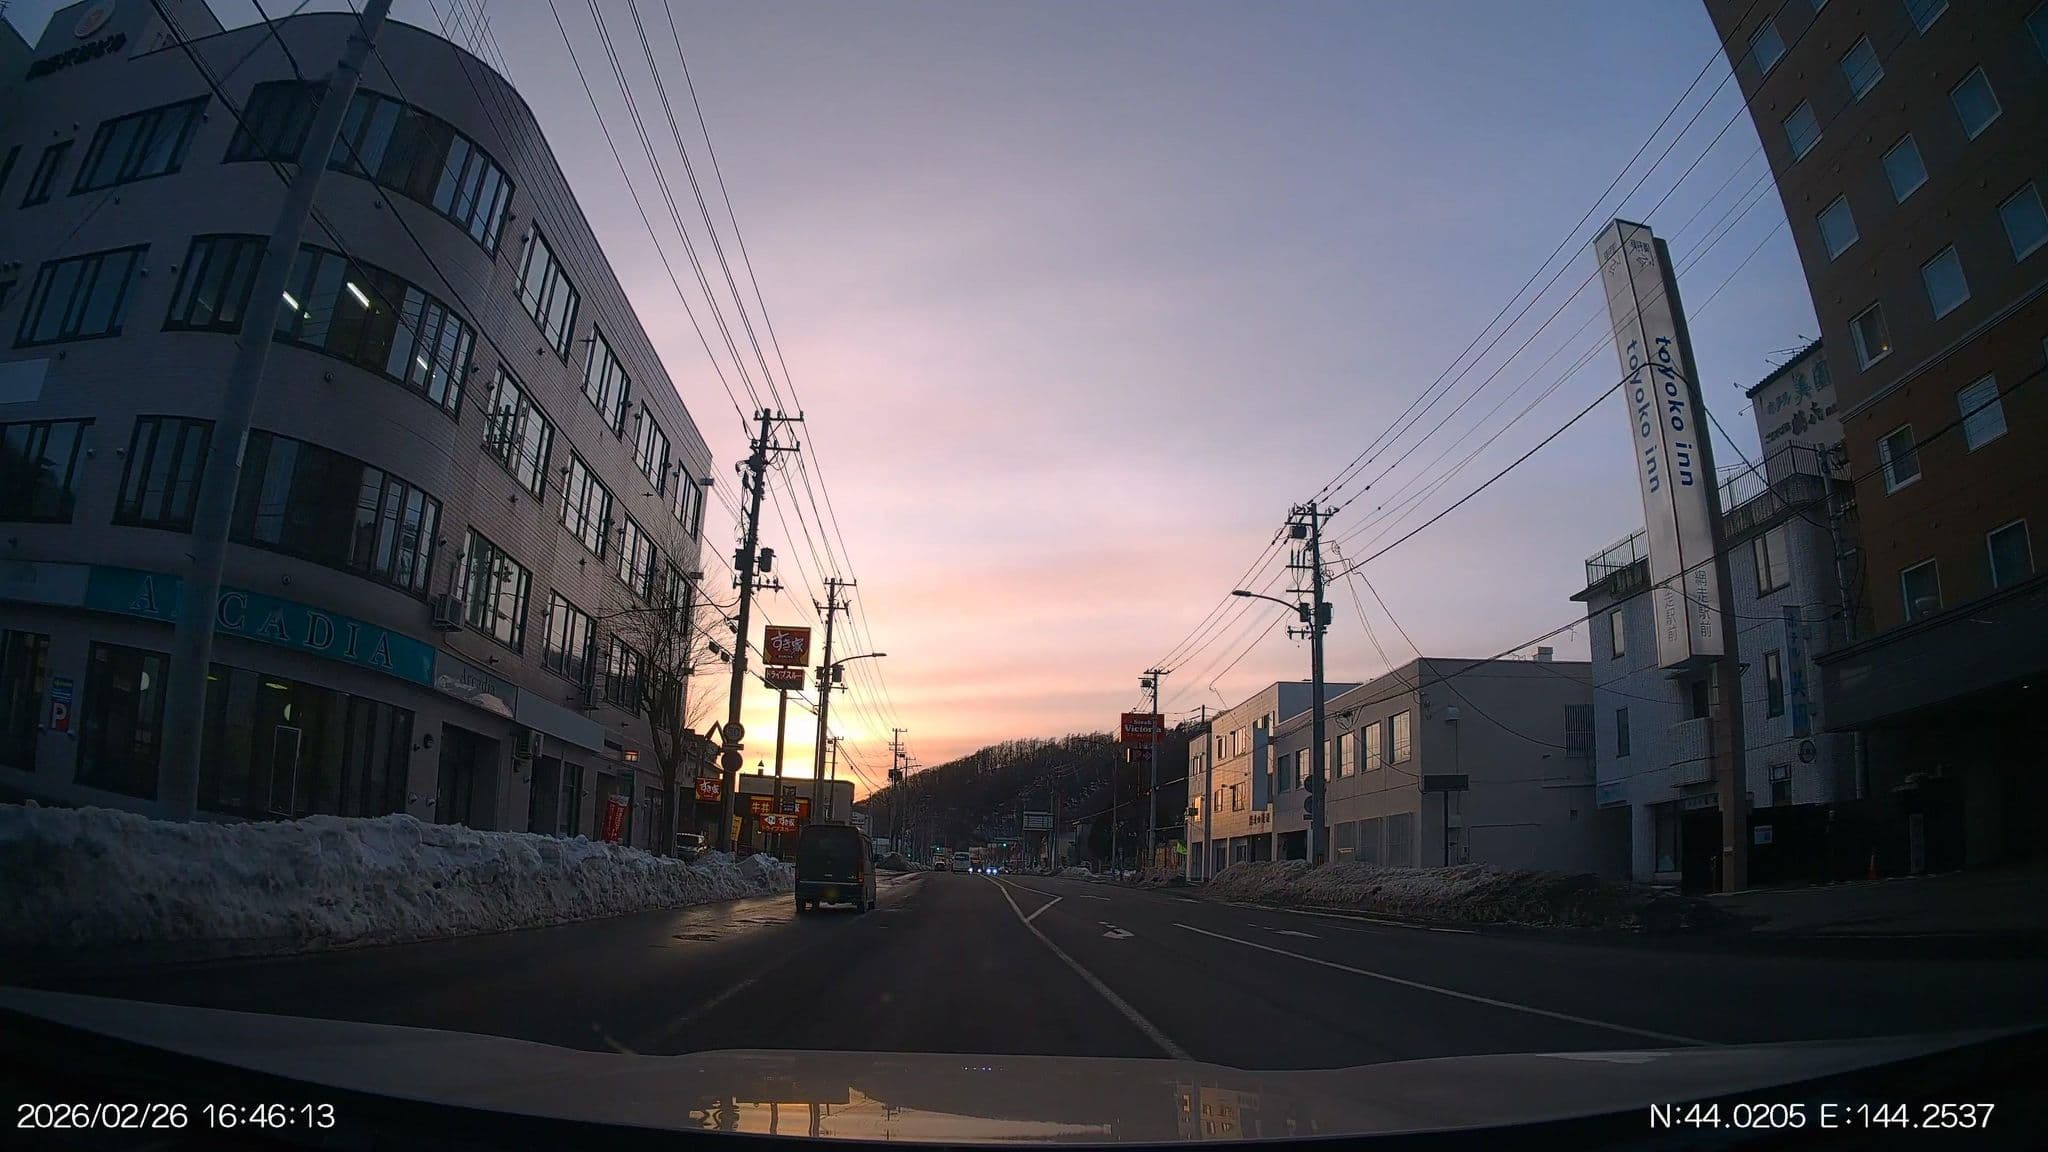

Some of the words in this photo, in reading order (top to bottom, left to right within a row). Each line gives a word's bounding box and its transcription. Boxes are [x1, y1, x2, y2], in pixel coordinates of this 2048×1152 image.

[1627, 338, 1650, 438] toyoko
[1645, 445, 1660, 493] inn
[1655, 336, 1685, 432] toyoko
[1675, 442, 1694, 486] inn
[130, 575, 394, 670] ACADIA
[770, 629, 804, 653] すき家
[52, 702, 68, 729] P
[1124, 724, 1162, 733] Victora
[700, 780, 720, 794] すき家
[751, 801, 770, 815] 牛丼
[775, 814, 796, 827] すき家
